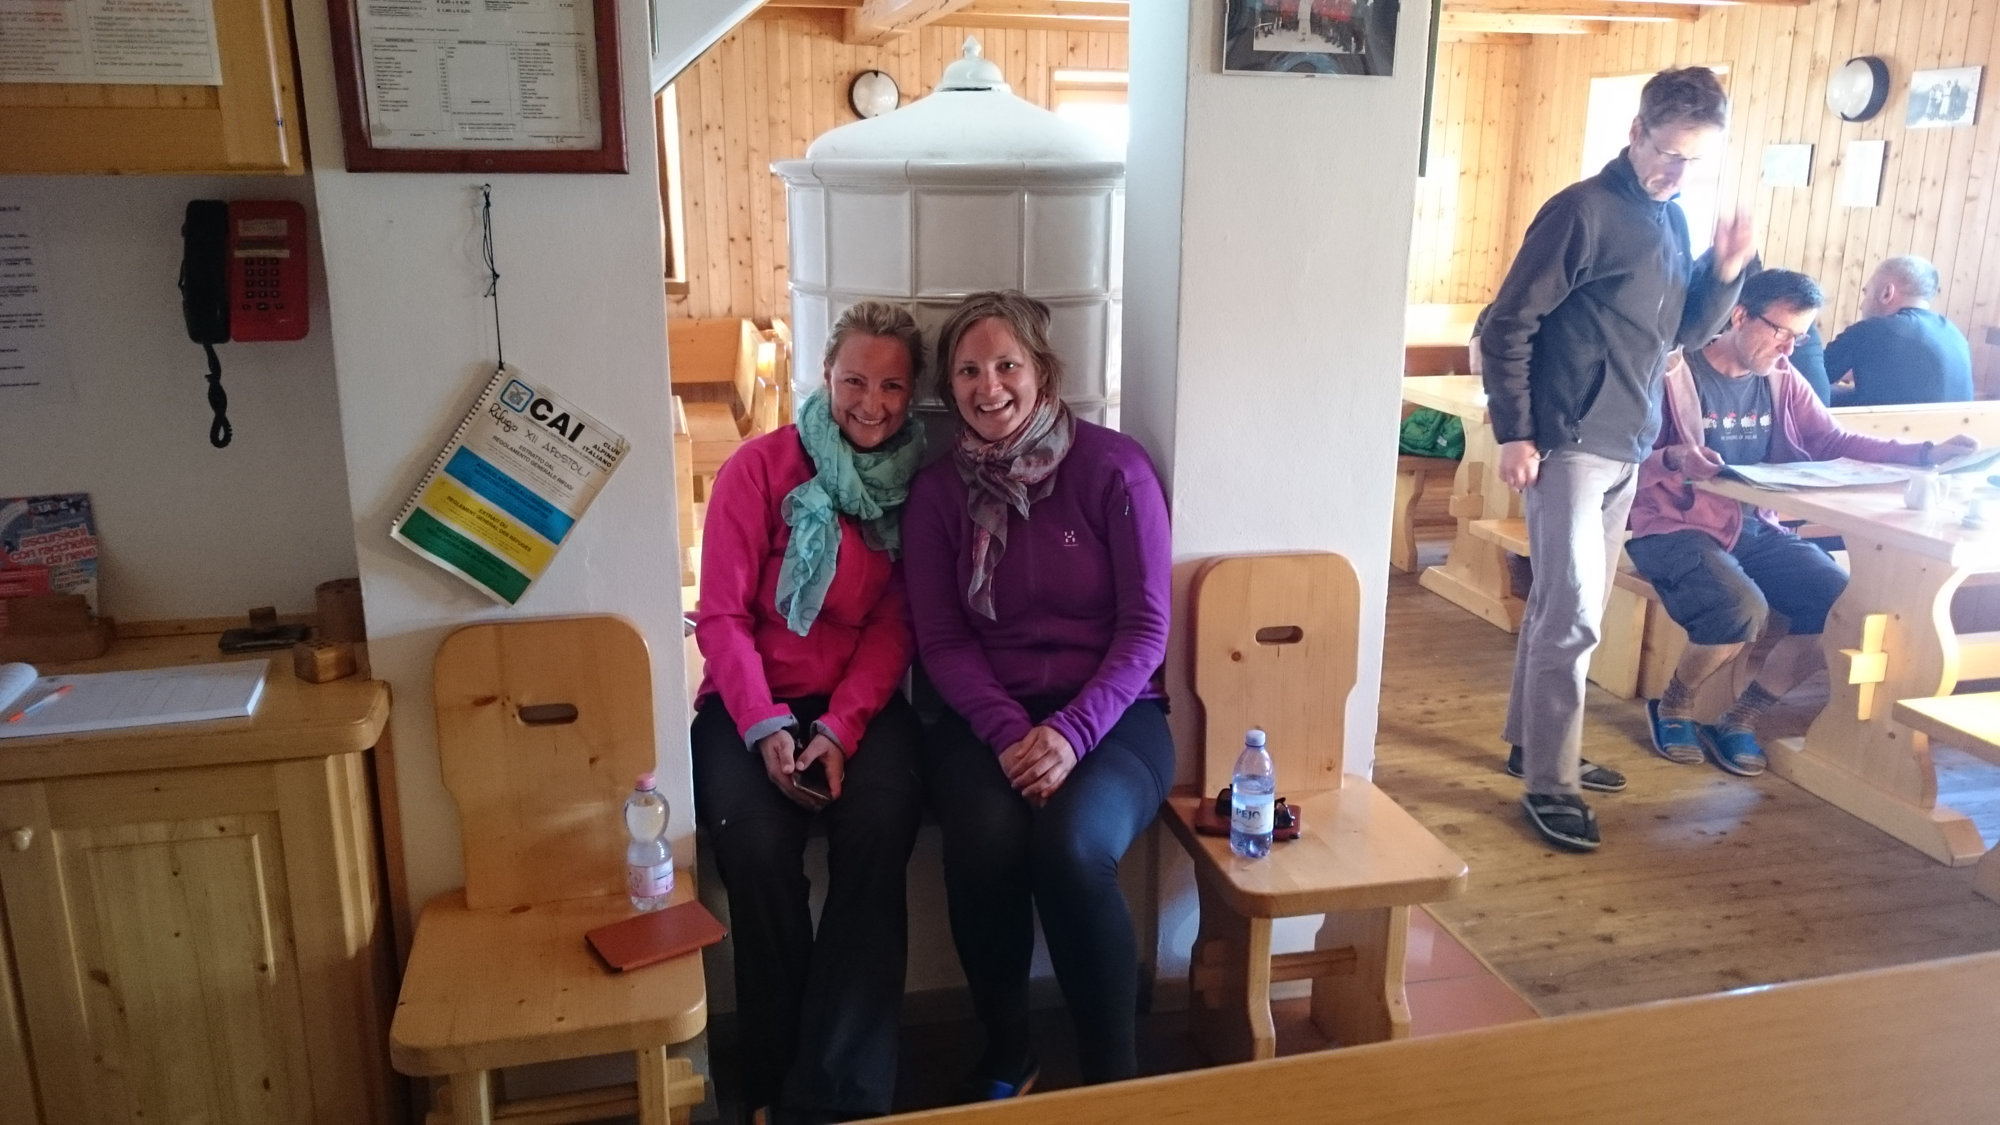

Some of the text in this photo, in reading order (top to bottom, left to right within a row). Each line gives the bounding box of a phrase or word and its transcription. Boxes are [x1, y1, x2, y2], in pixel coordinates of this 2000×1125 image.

[530, 398, 585, 442] CAI
[519, 445, 554, 471] ESTRATTO DAL
[542, 442, 590, 478] APOSTOLI
[582, 446, 612, 468] ITALIANO
[593, 444, 616, 462] ALPINO
[603, 442, 621, 456] CLUB
[493, 435, 530, 463] REGOLAMENTO
[531, 459, 558, 480] GENERALE
[557, 478, 574, 491] RIFUGI
[478, 508, 500, 524] EXTRAIT
